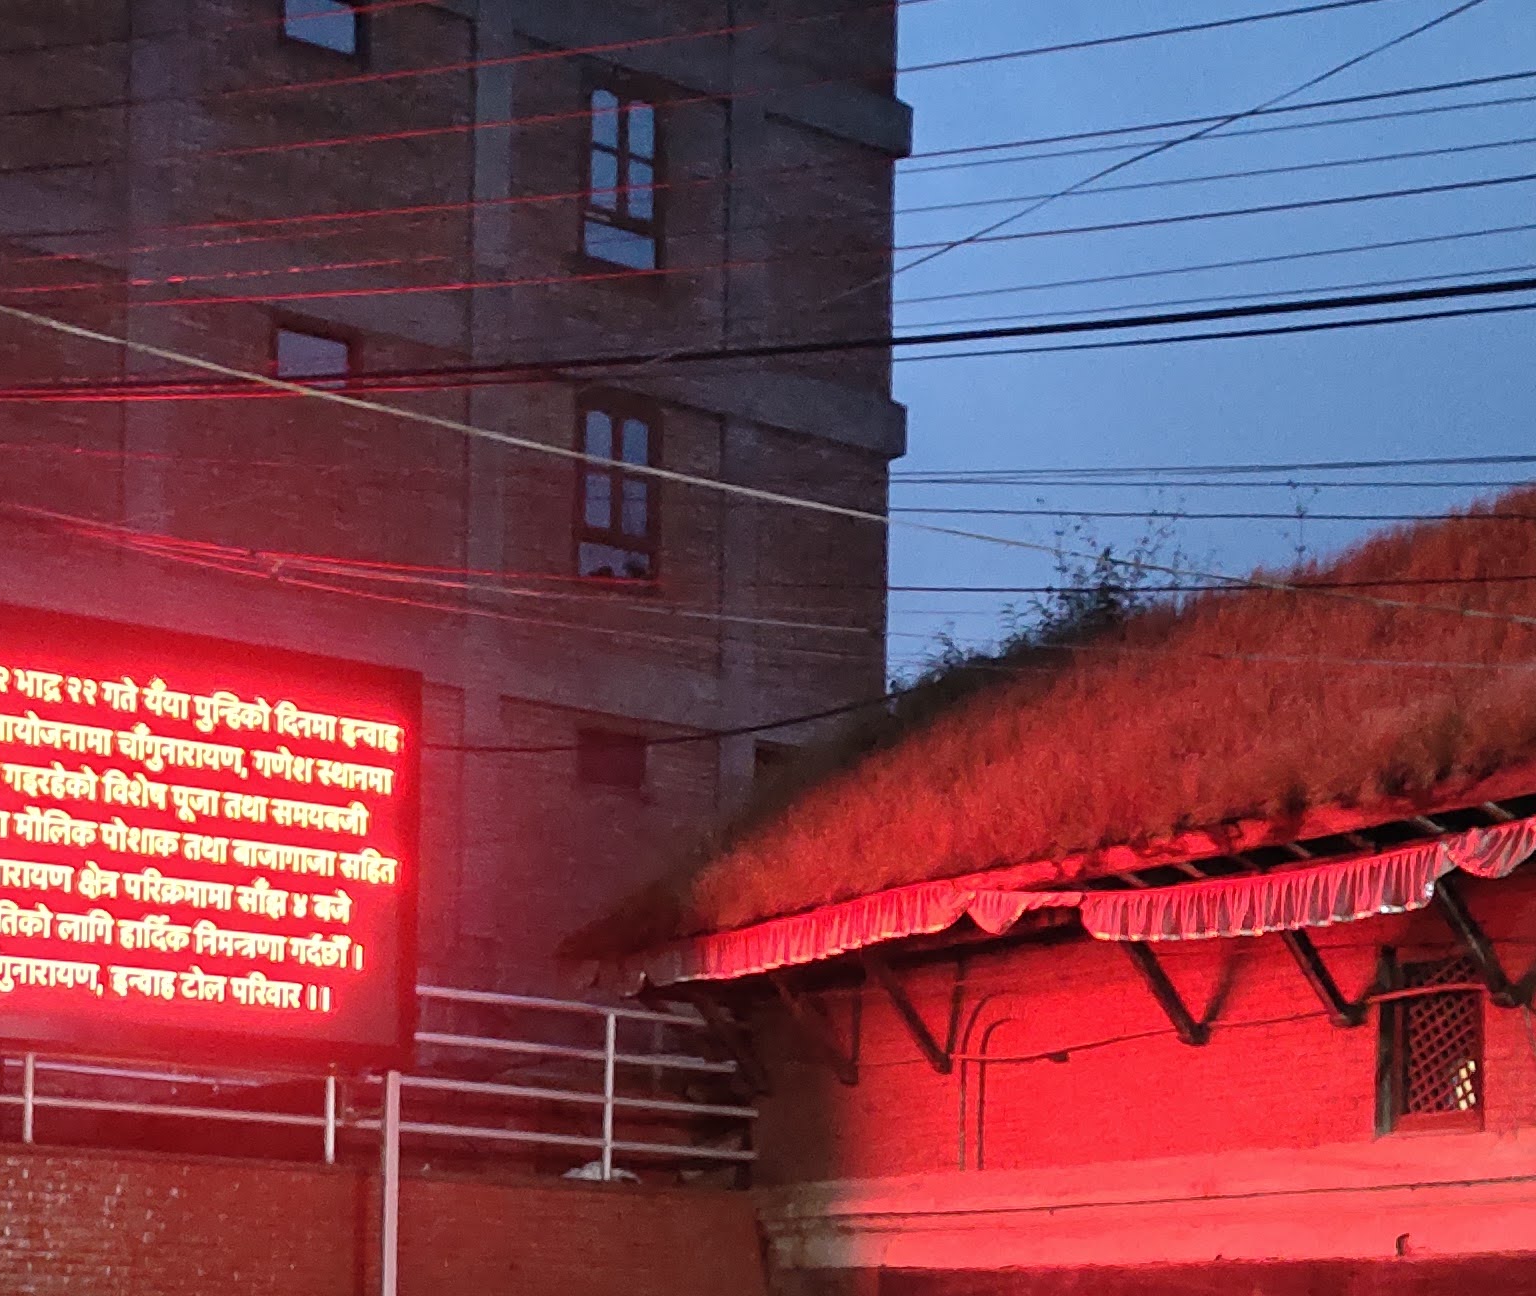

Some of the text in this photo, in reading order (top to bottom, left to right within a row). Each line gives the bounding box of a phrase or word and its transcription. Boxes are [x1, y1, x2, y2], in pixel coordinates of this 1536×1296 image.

[12, 667, 63, 702] भाद्र
[66, 675, 97, 705] २२
[100, 675, 140, 713] गते
[273, 699, 338, 742] दिनमा
[0, 760, 100, 801] गइरहेको
[99, 768, 169, 810] विशेष
[169, 784, 221, 823] पूजा
[221, 790, 270, 823] तथा
[269, 797, 370, 836] समयबजी
[250, 745, 315, 783] गणेश
[315, 758, 394, 795] स्थानमा
[11, 804, 99, 847] मौलिक
[98, 815, 181, 857] पोशाक
[181, 832, 230, 864] तथा
[230, 838, 338, 877] बाजागाजा
[337, 846, 398, 885] सहित
[76, 859, 121, 900] क्षेत्र
[121, 866, 235, 911] परिक्रमामा
[234, 876, 289, 919] साँझ
[291, 892, 308, 918] ४
[311, 888, 353, 924] बजे
[54, 907, 115, 945] लागि
[116, 913, 192, 952] हार्दिक
[174, 967, 228, 1002] टोल
[228, 970, 303, 1009] परिवार
